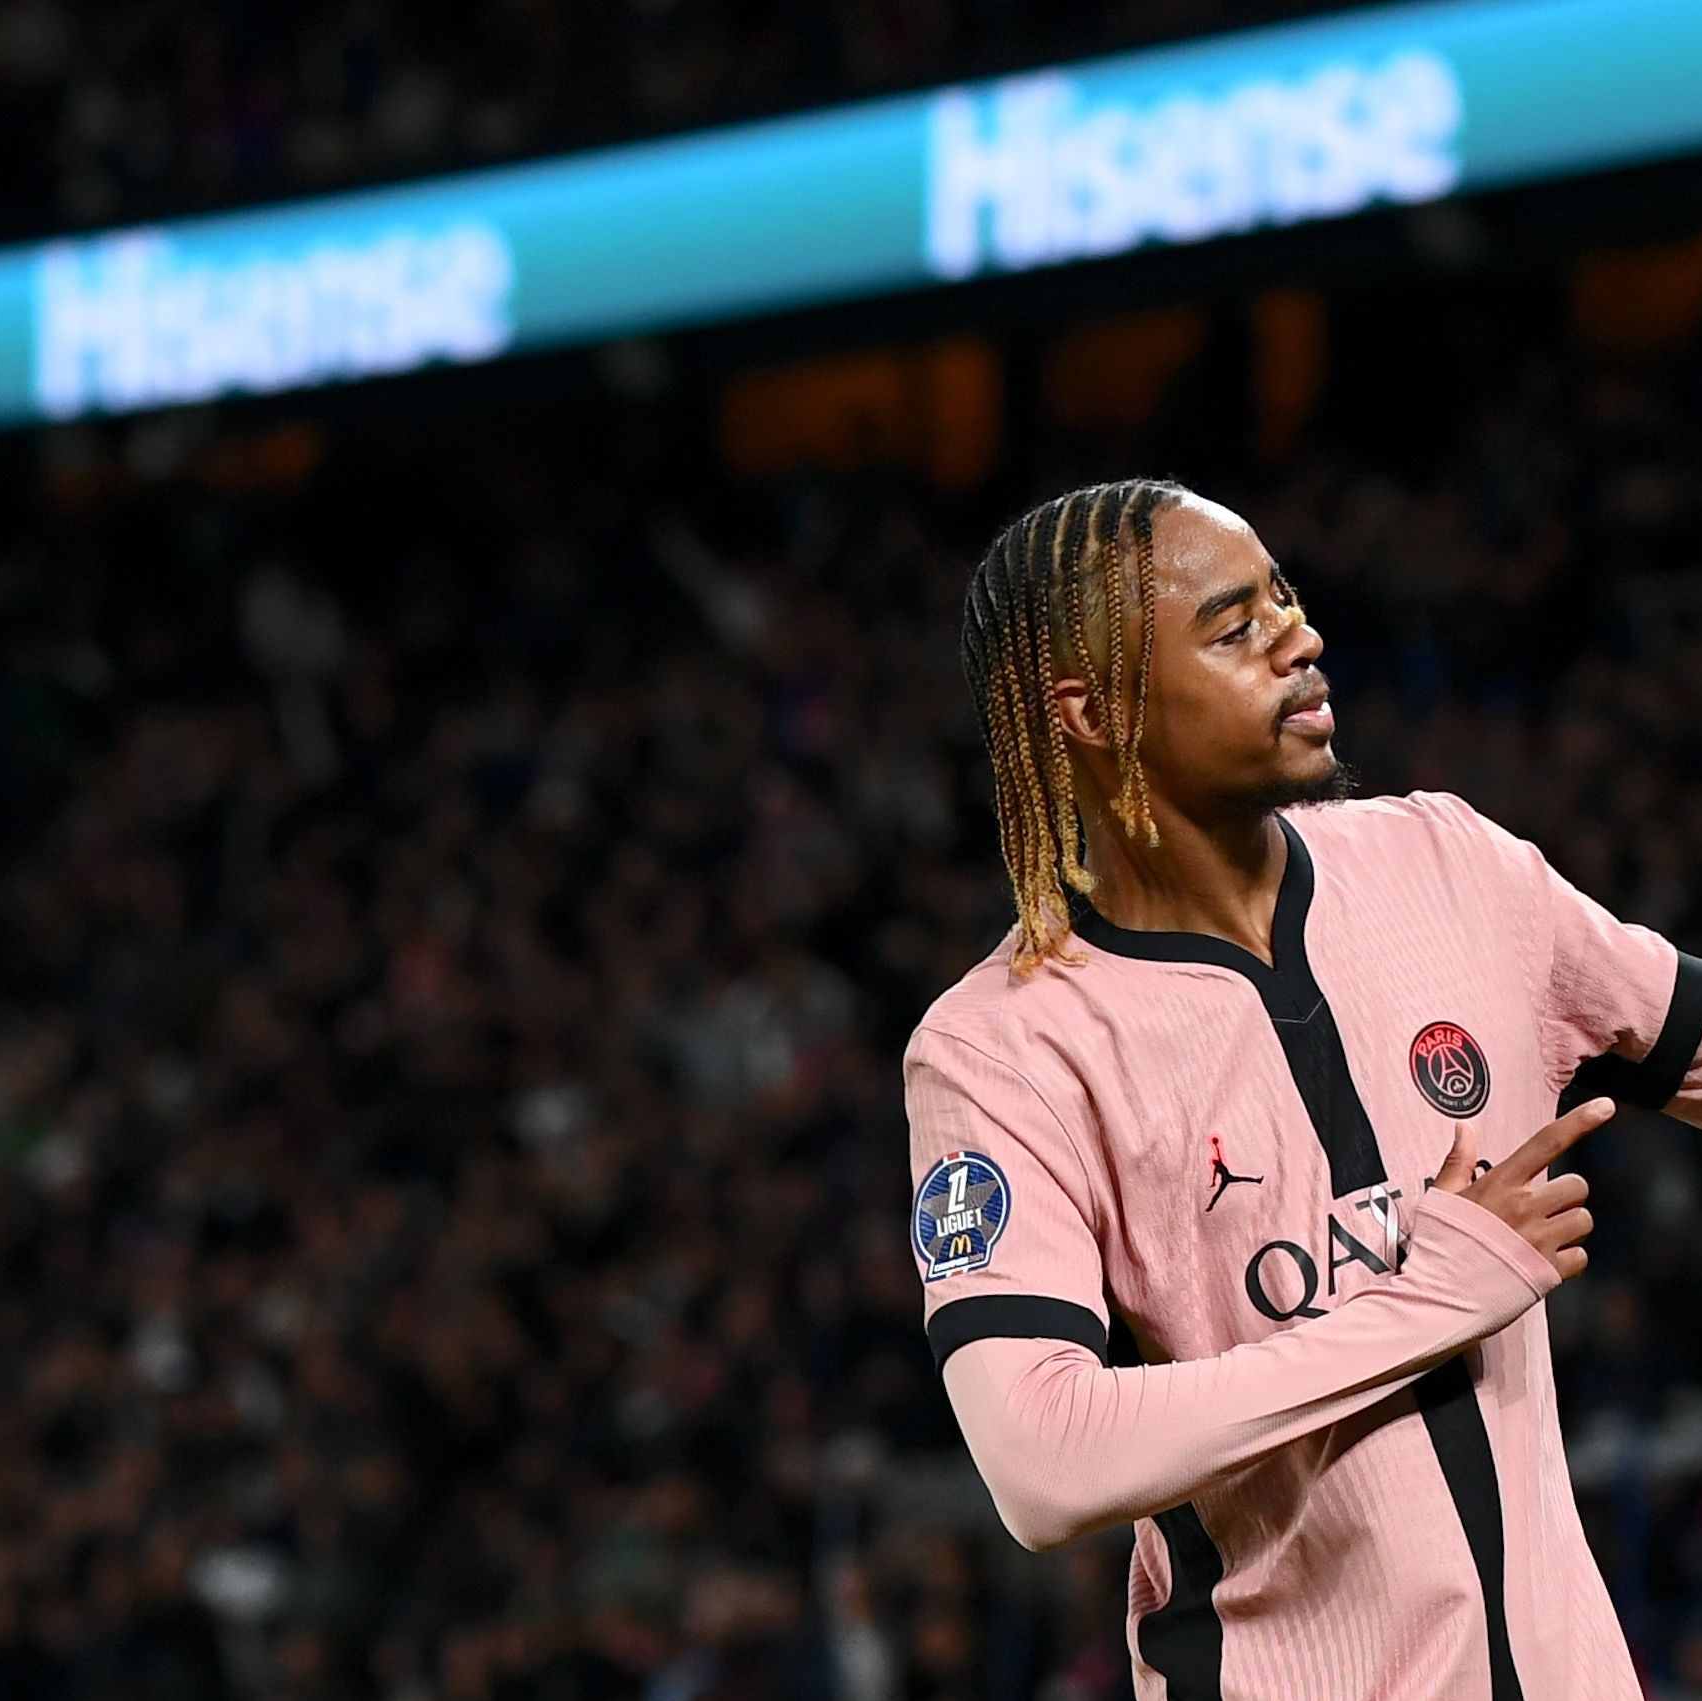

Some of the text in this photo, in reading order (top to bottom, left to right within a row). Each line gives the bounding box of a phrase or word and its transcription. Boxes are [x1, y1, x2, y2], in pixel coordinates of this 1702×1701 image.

[927, 54, 1460, 280] Hisense
[1417, 1029, 1463, 1057] PARIS
[936, 1209, 975, 1238] LIGUE
